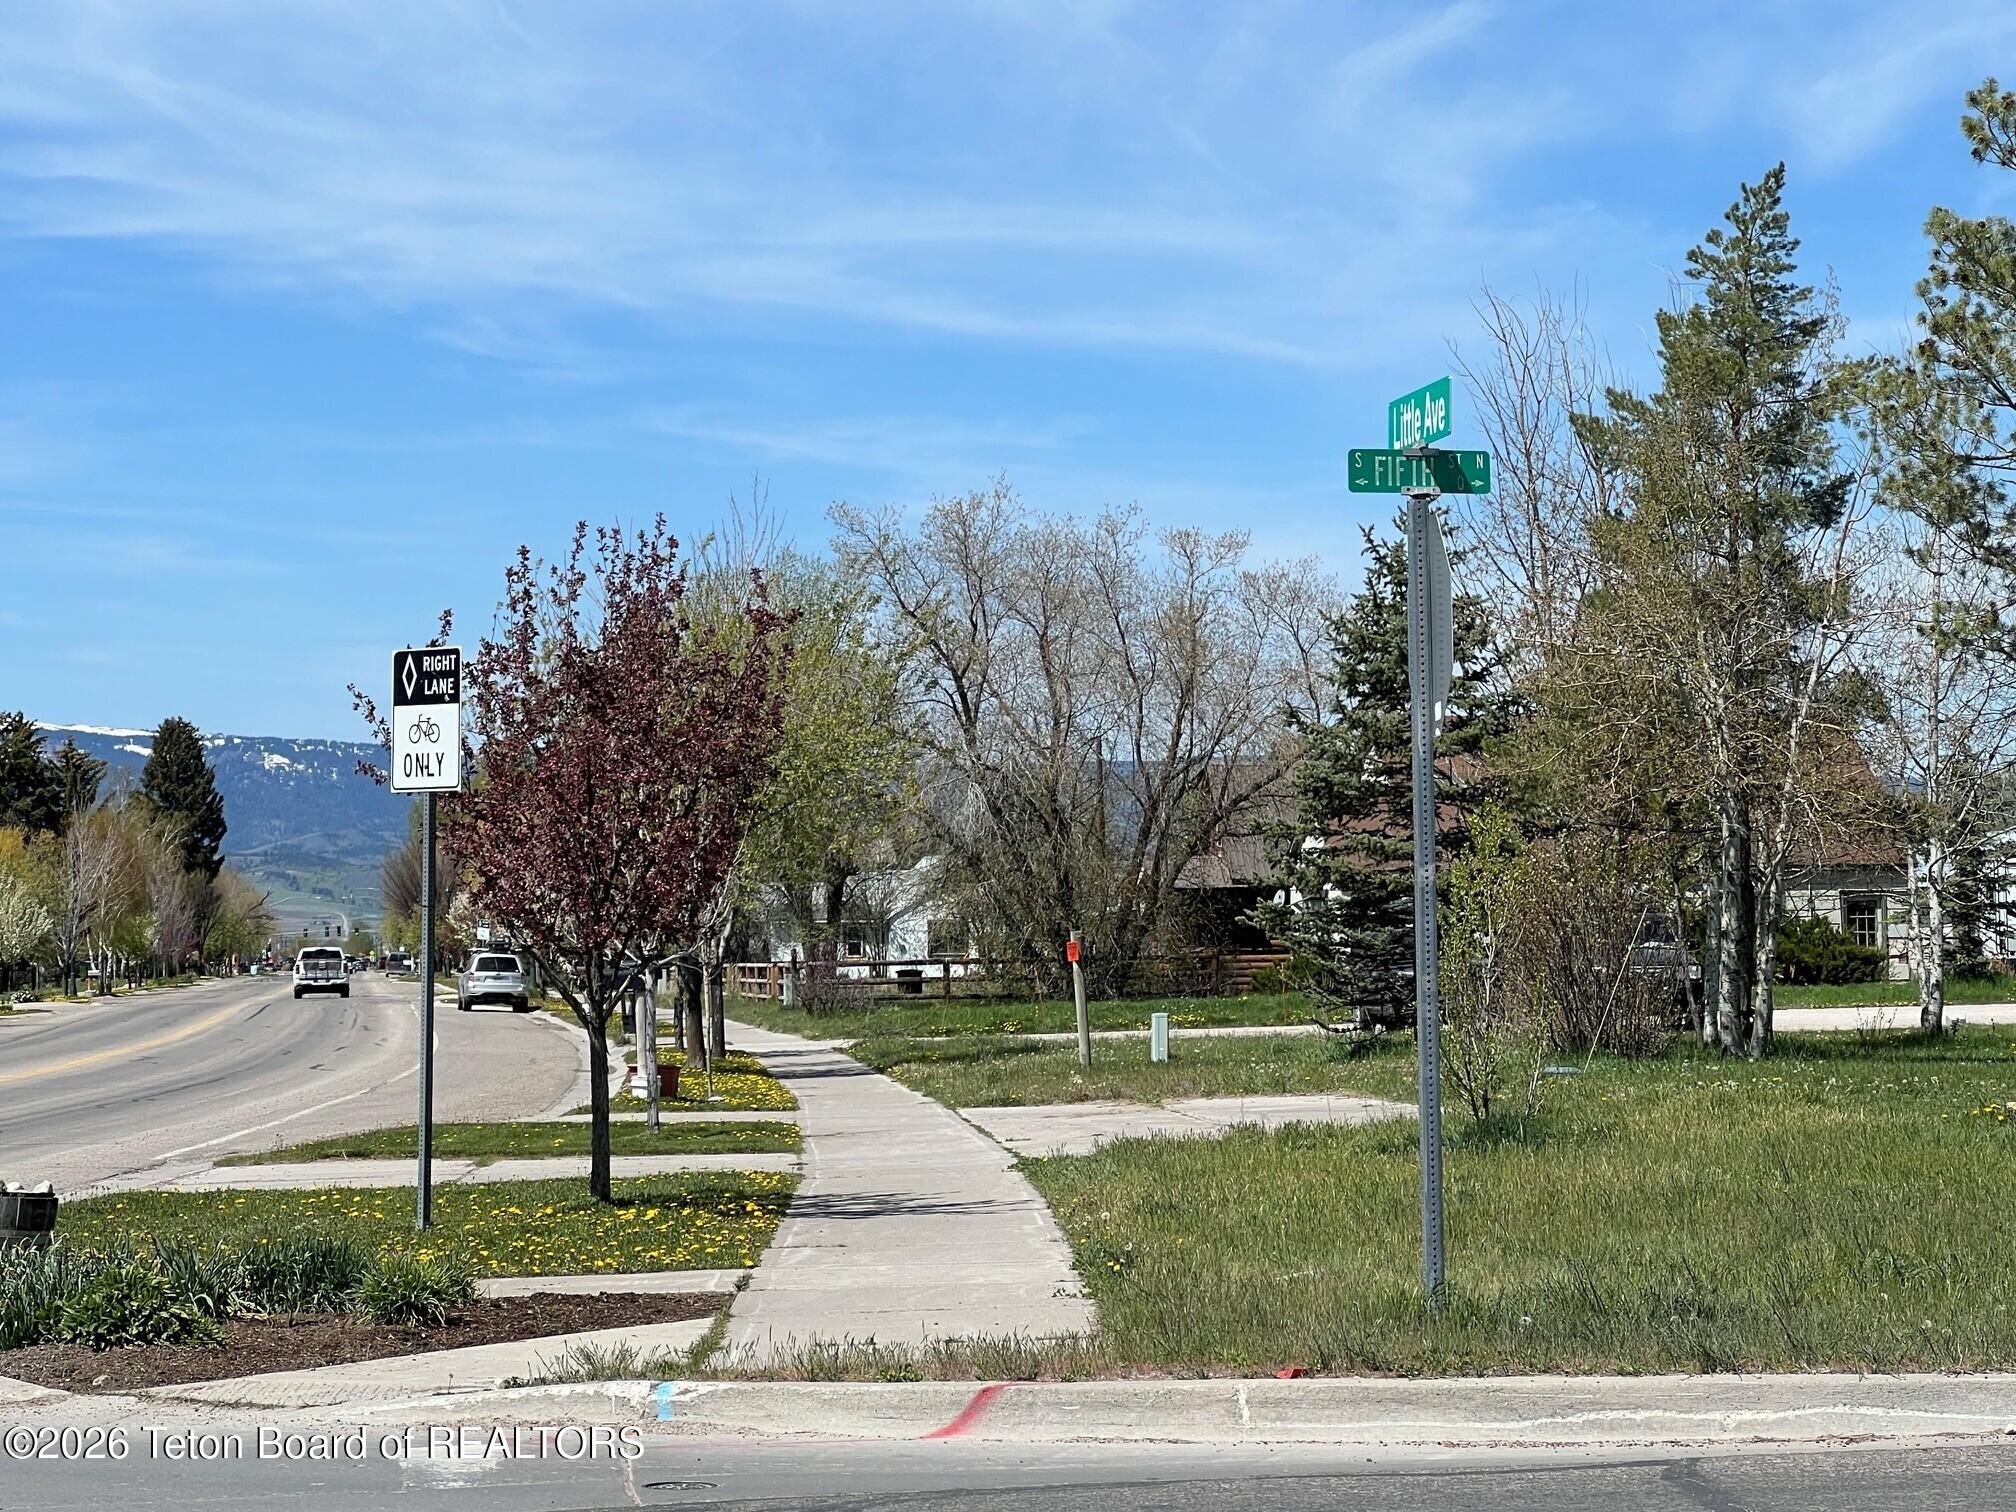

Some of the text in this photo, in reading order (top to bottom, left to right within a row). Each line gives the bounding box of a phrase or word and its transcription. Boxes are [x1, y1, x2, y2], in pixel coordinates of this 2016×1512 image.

[1393, 391, 1446, 449] Little Ave
[1355, 452, 1484, 487] S FIFTH ST N
[422, 654, 457, 672] RIGHT
[424, 677, 455, 695] LANE
[403, 752, 445, 778] ONLY
